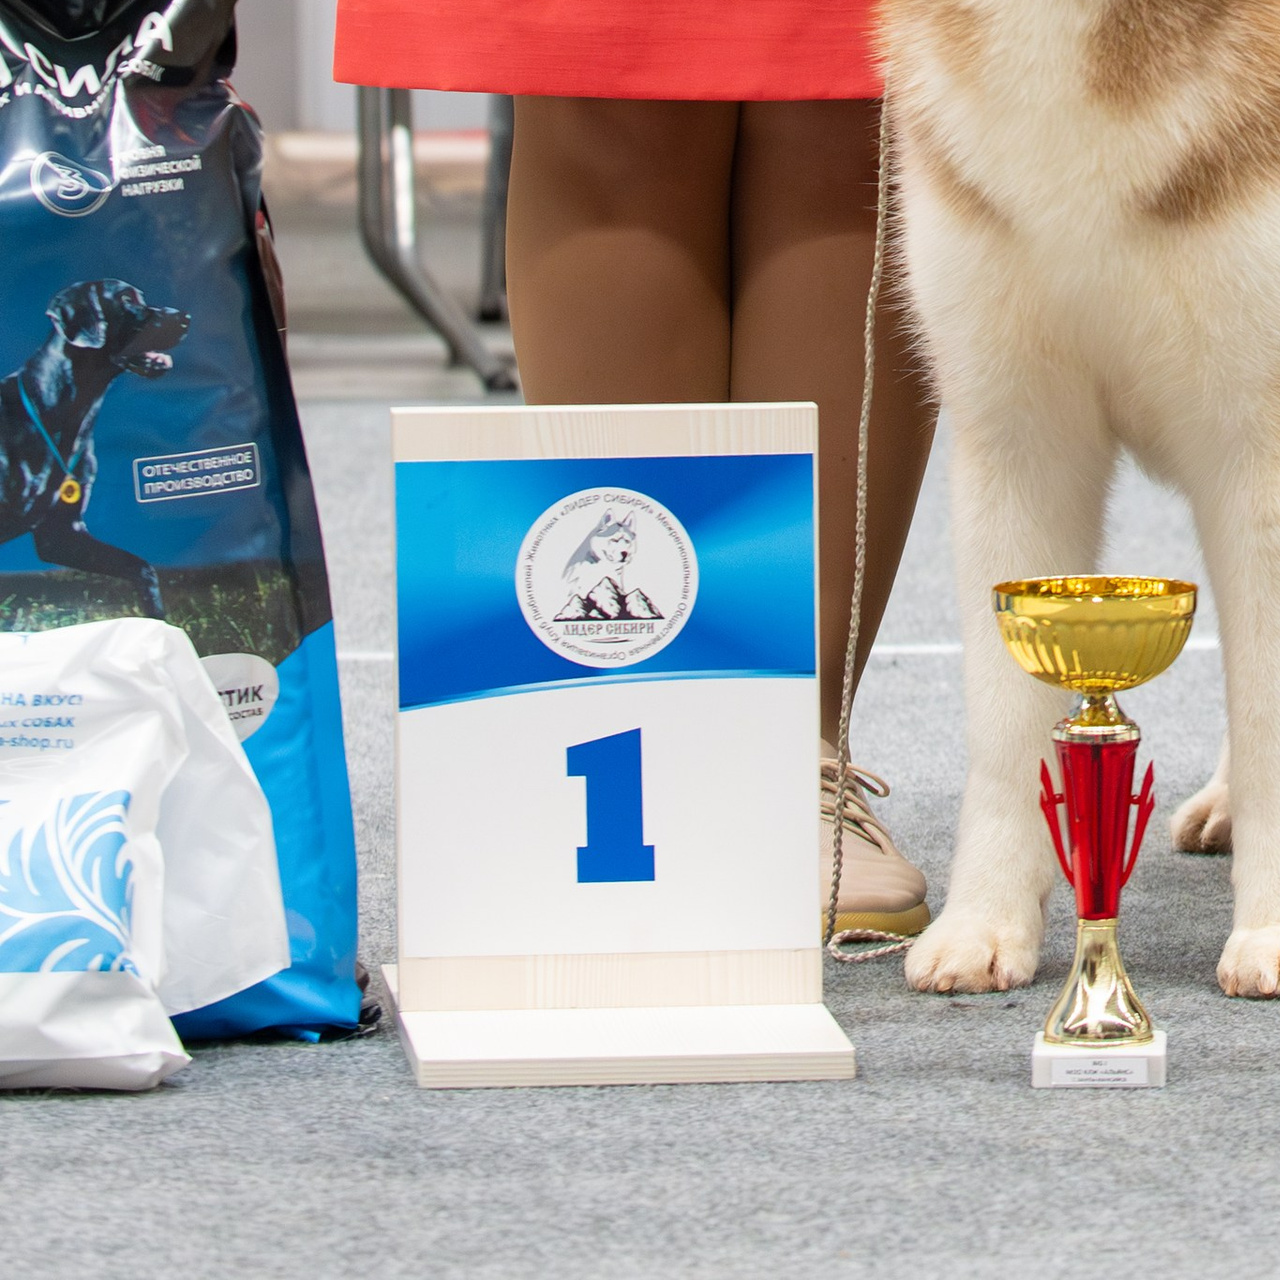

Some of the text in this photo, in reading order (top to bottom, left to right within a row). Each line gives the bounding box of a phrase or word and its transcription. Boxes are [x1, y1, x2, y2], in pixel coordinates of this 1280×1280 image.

[121, 178, 185, 197] НАГРУЗКИ
[142, 451, 253, 477] ОТЕЧЕСТВЕННОЕ
[144, 468, 254, 494] ПРОИЗВОДСТВО
[562, 622, 655, 637] ЛИДЕР СИБИРИ
[566, 727, 655, 883] 1
